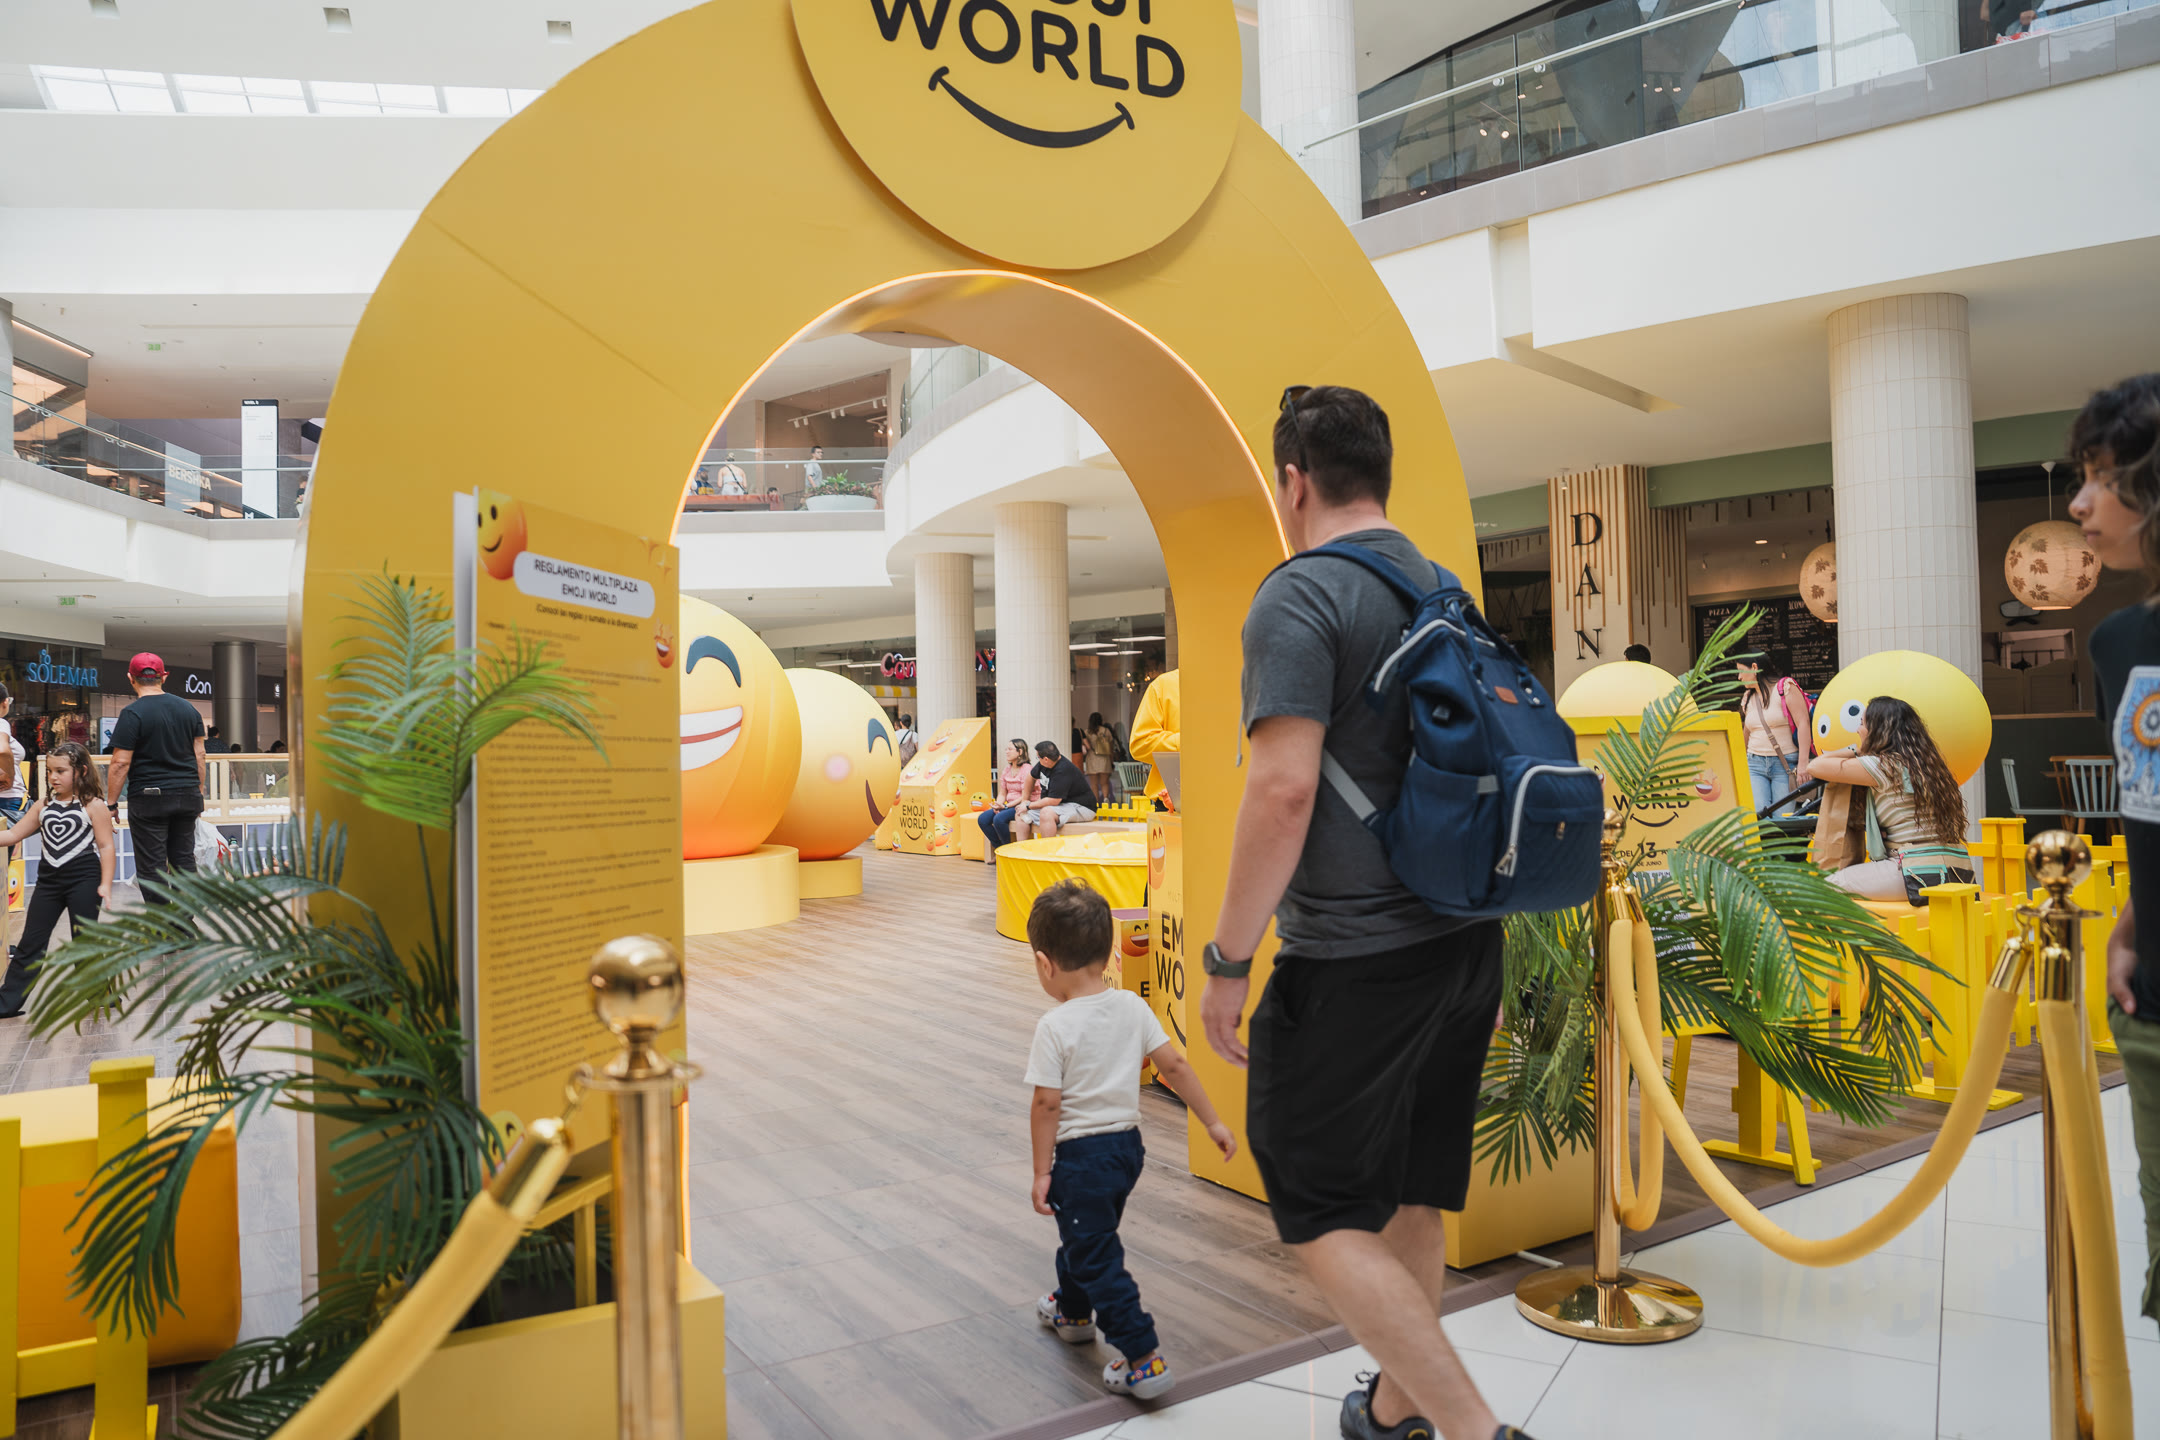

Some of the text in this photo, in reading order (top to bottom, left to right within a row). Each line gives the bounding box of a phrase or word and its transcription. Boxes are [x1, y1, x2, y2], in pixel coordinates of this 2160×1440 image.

[870, 0, 1185, 98] WORLD
[168, 464, 212, 491] BERSHKA
[534, 559, 639, 593] REGLAMENTO MULTIPLAZA
[562, 583, 618, 605] EMOJI WORLD
[1708, 607, 1731, 617] PIZZA
[27, 662, 99, 687] SOLEMAR
[880, 652, 917, 680] Can
[902, 804, 925, 817] EMOJI
[899, 817, 928, 830] WORLD
[1637, 842, 1657, 858] 13
[1645, 859, 1662, 867] JUNIO
[1161, 911, 1184, 957] EM
[1155, 950, 1185, 1001] WO
